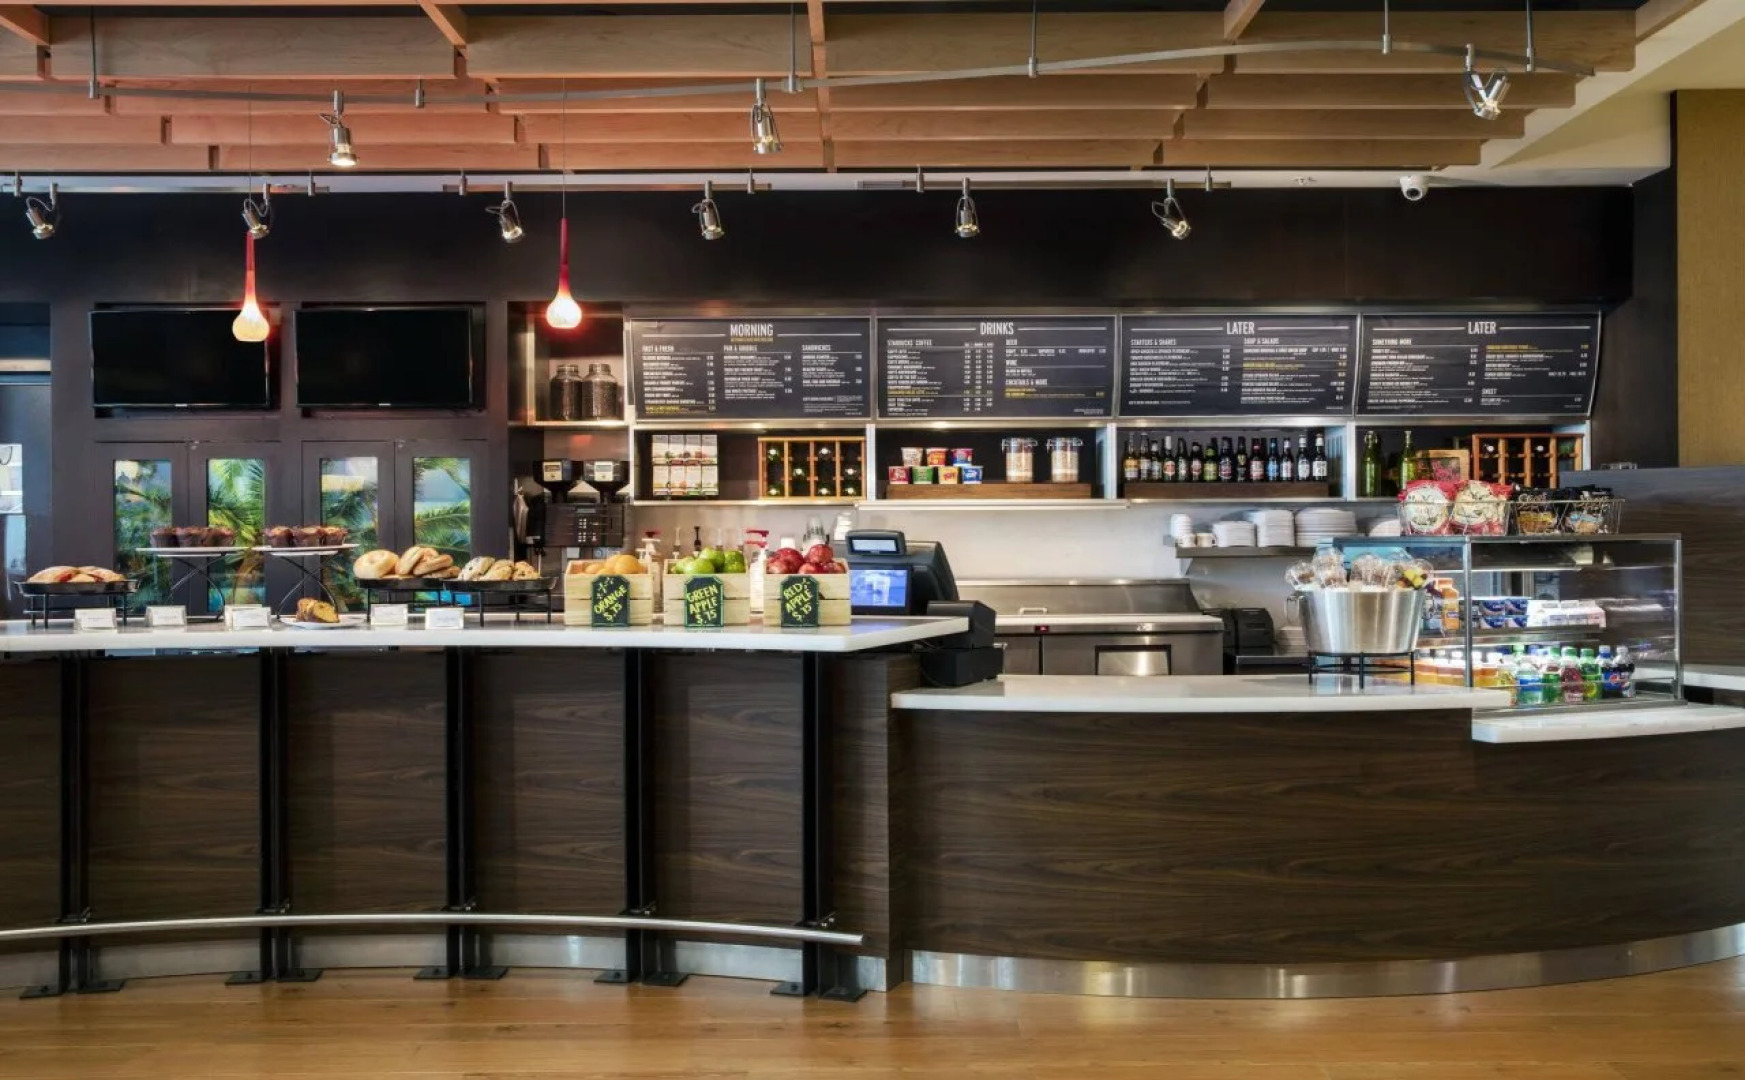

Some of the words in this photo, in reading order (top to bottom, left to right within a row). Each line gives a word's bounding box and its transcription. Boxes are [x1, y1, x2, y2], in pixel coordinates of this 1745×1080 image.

[730, 324, 774, 337] MORNING
[980, 322, 1014, 335] DRINKS
[1227, 322, 1255, 335] LATER
[1468, 321, 1497, 334] LATER
[594, 585, 627, 614] ORANGE
[686, 585, 718, 602] GREEN
[783, 583, 803, 600] RED
[689, 597, 718, 614] APPLE
[785, 589, 813, 613] APPLE
